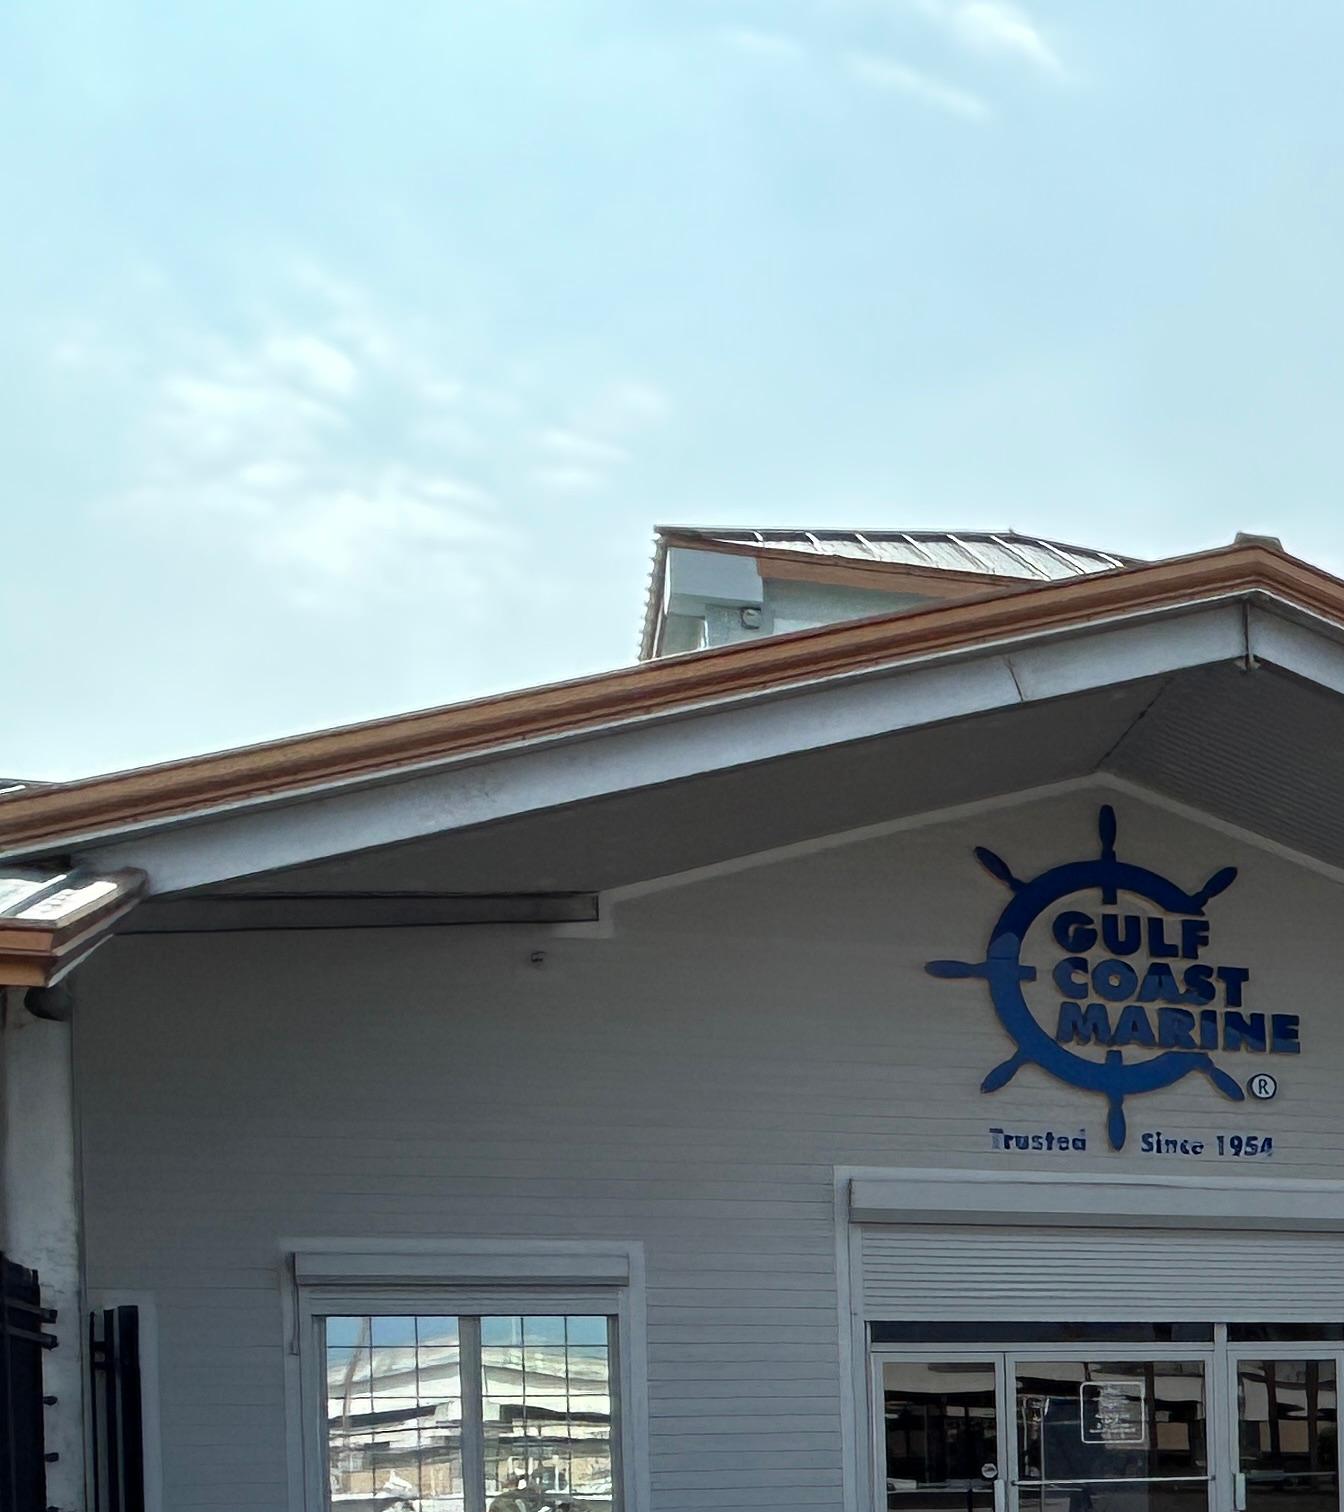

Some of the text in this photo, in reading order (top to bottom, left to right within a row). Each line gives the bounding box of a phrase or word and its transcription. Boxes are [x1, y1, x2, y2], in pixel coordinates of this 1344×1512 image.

[1052, 910, 1210, 960] GULF
[1052, 956, 1250, 1008] COAST
[1056, 1002, 1301, 1054] MARINE
[1140, 1131, 1205, 1156] Since
[1216, 1135, 1274, 1157] 1954
